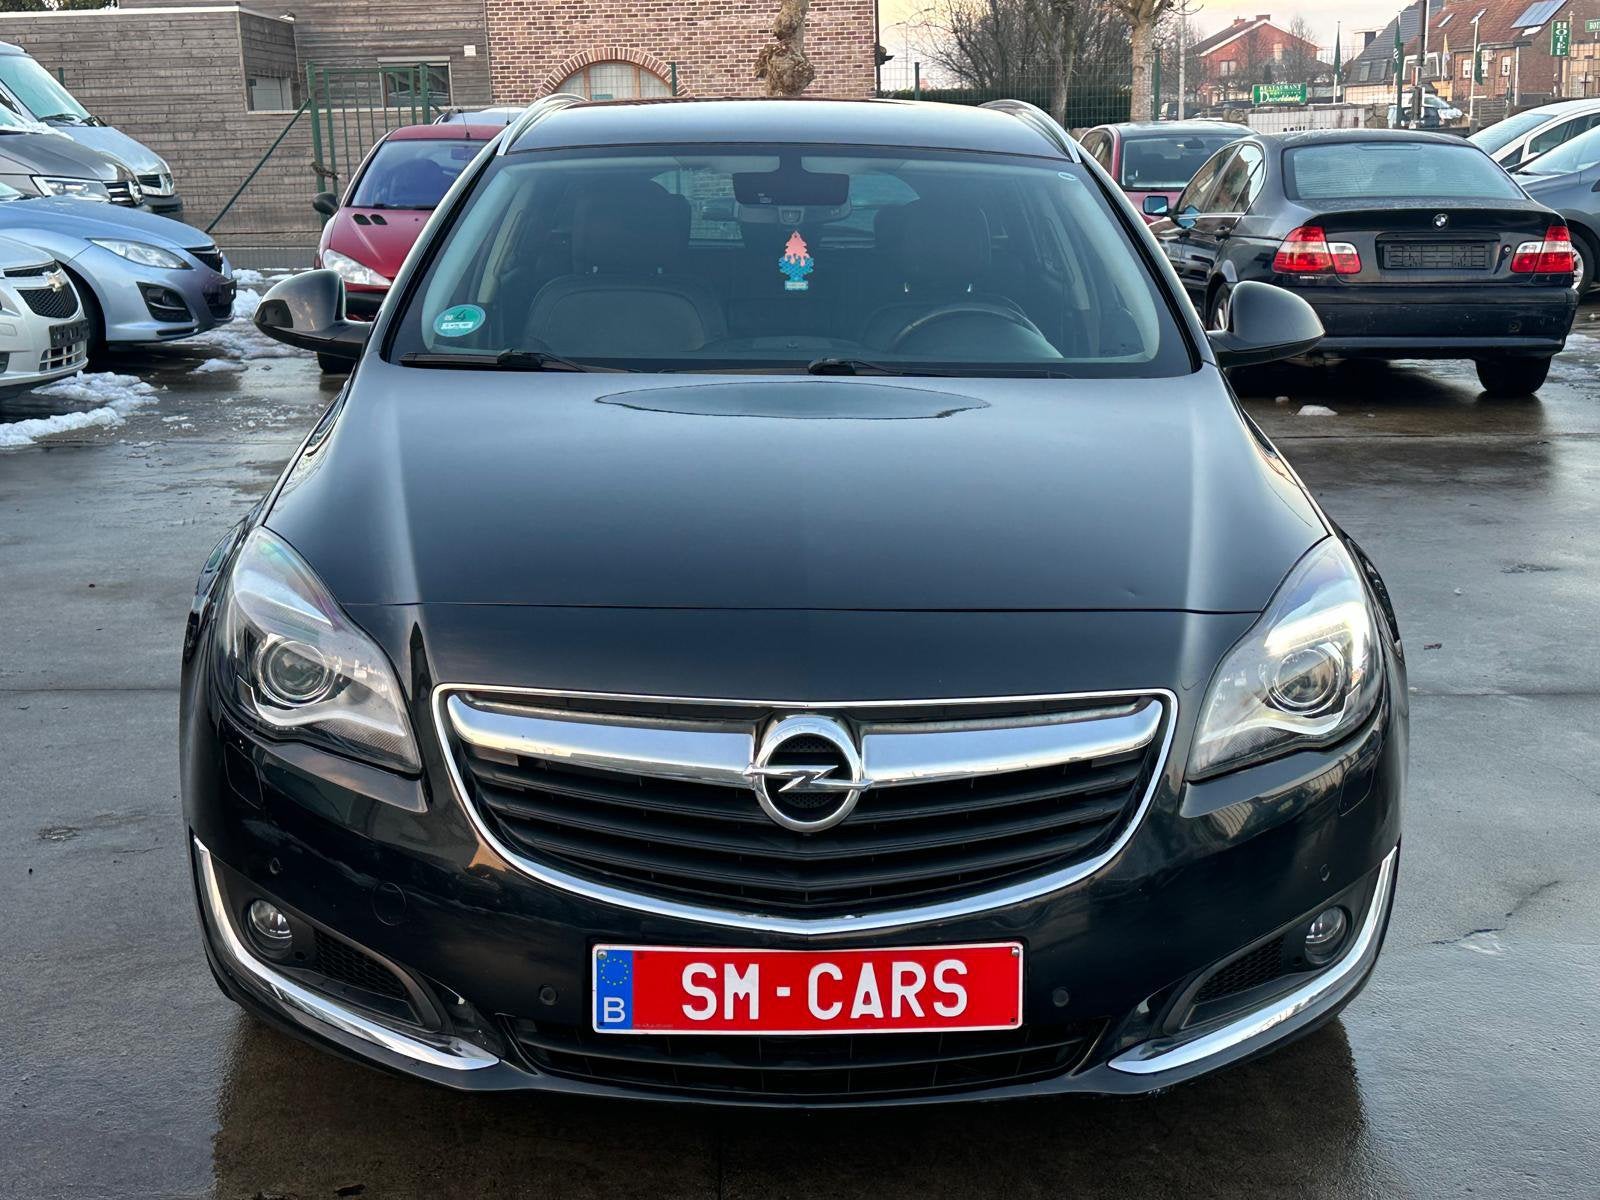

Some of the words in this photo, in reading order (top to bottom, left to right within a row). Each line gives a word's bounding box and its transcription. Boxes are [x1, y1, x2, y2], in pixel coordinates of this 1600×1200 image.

[1556, 22, 1568, 56] HOTEL
[681, 962, 760, 1021] SM
[807, 959, 968, 1021] CARS
[603, 997, 626, 1023] B
